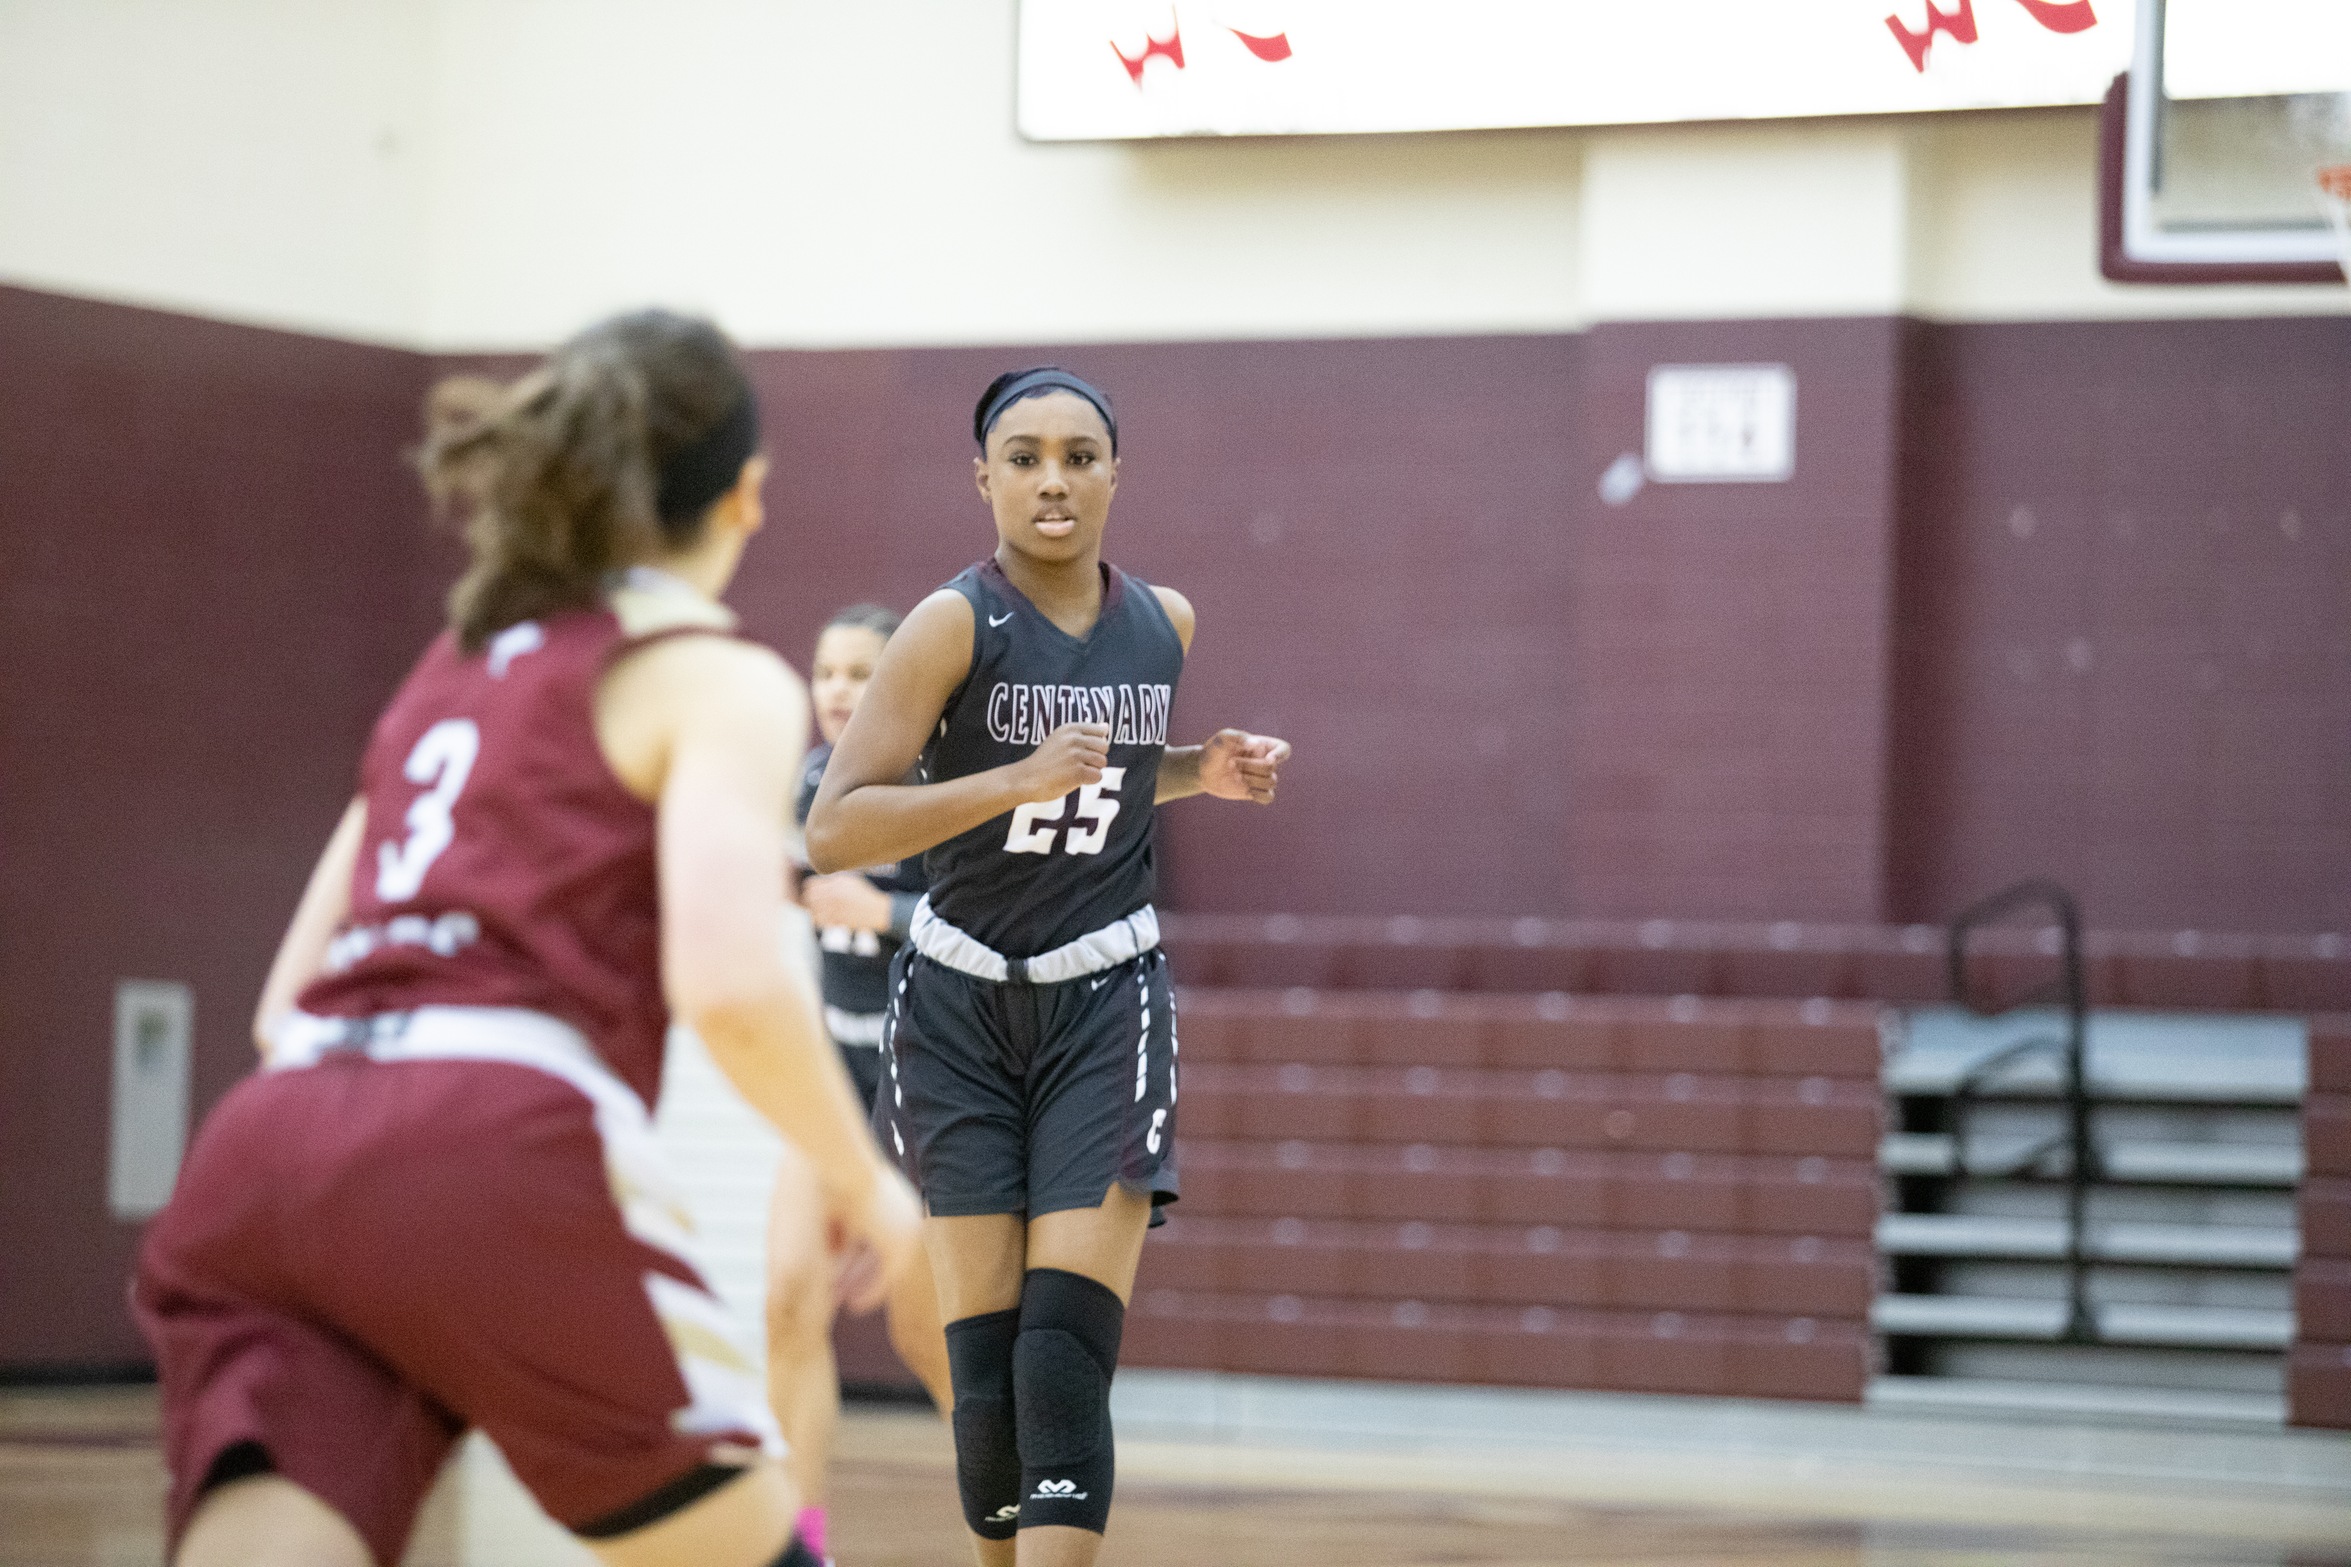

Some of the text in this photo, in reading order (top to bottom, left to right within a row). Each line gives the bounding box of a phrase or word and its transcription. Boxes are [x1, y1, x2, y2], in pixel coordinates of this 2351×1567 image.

[987, 682, 1171, 745] CENTENARY
[377, 718, 480, 901] 3
[1003, 767, 1127, 855] 25
